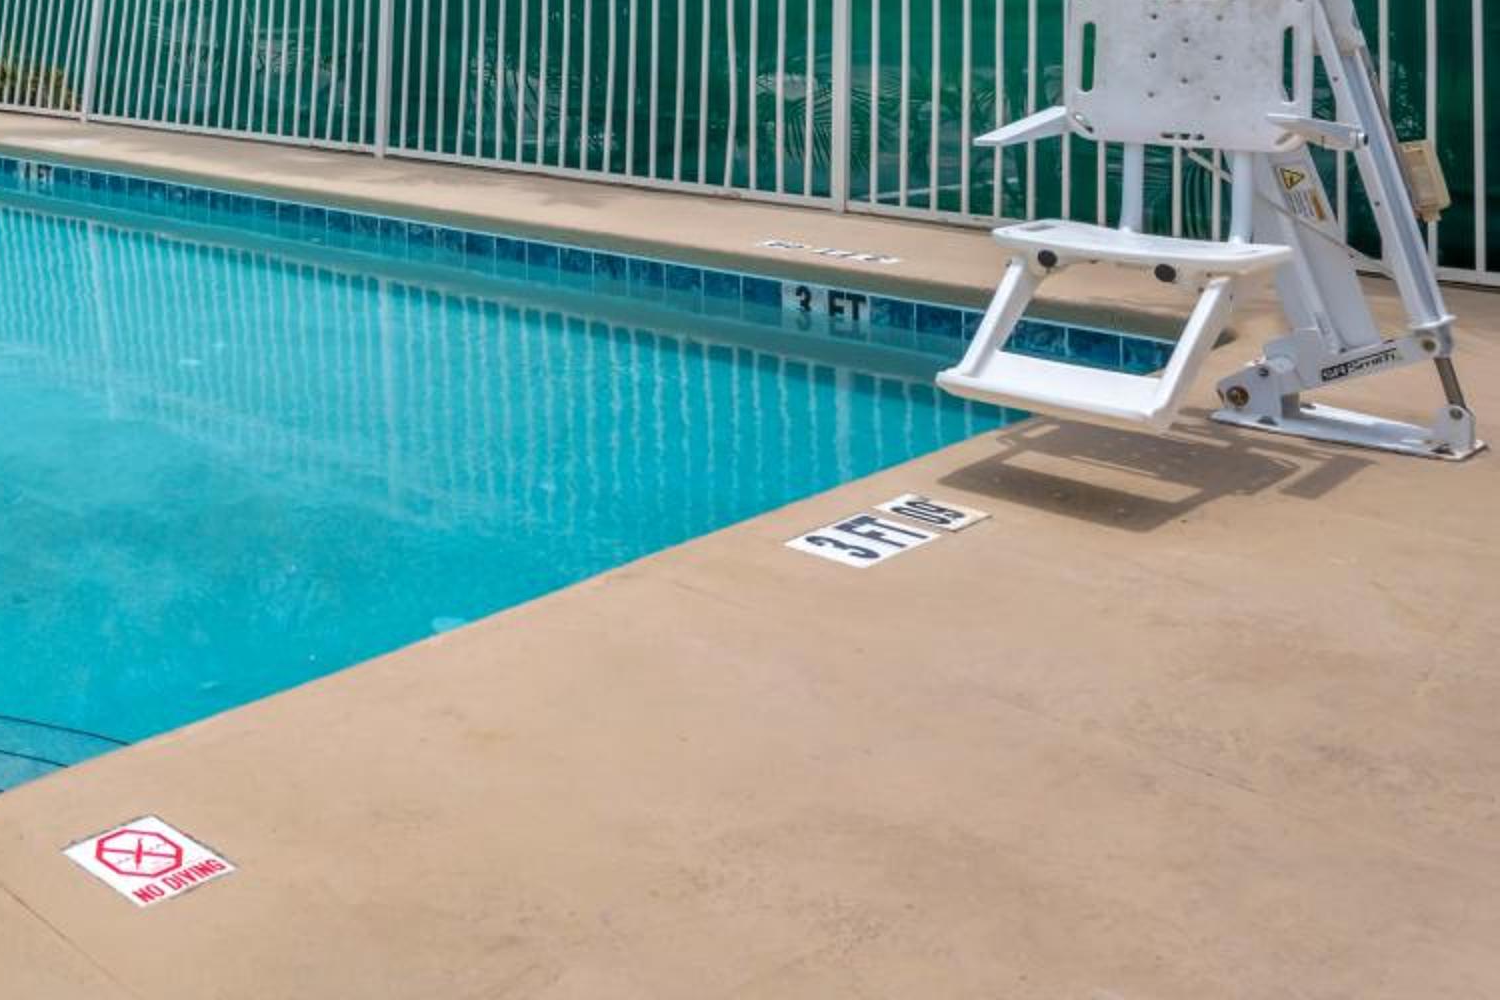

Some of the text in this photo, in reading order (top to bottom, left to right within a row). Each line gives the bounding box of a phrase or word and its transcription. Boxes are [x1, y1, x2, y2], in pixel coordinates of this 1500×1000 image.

[796, 285, 867, 321] 3 FT
[805, 515, 930, 559] 3 FT
[132, 858, 227, 903] NO DIVING
